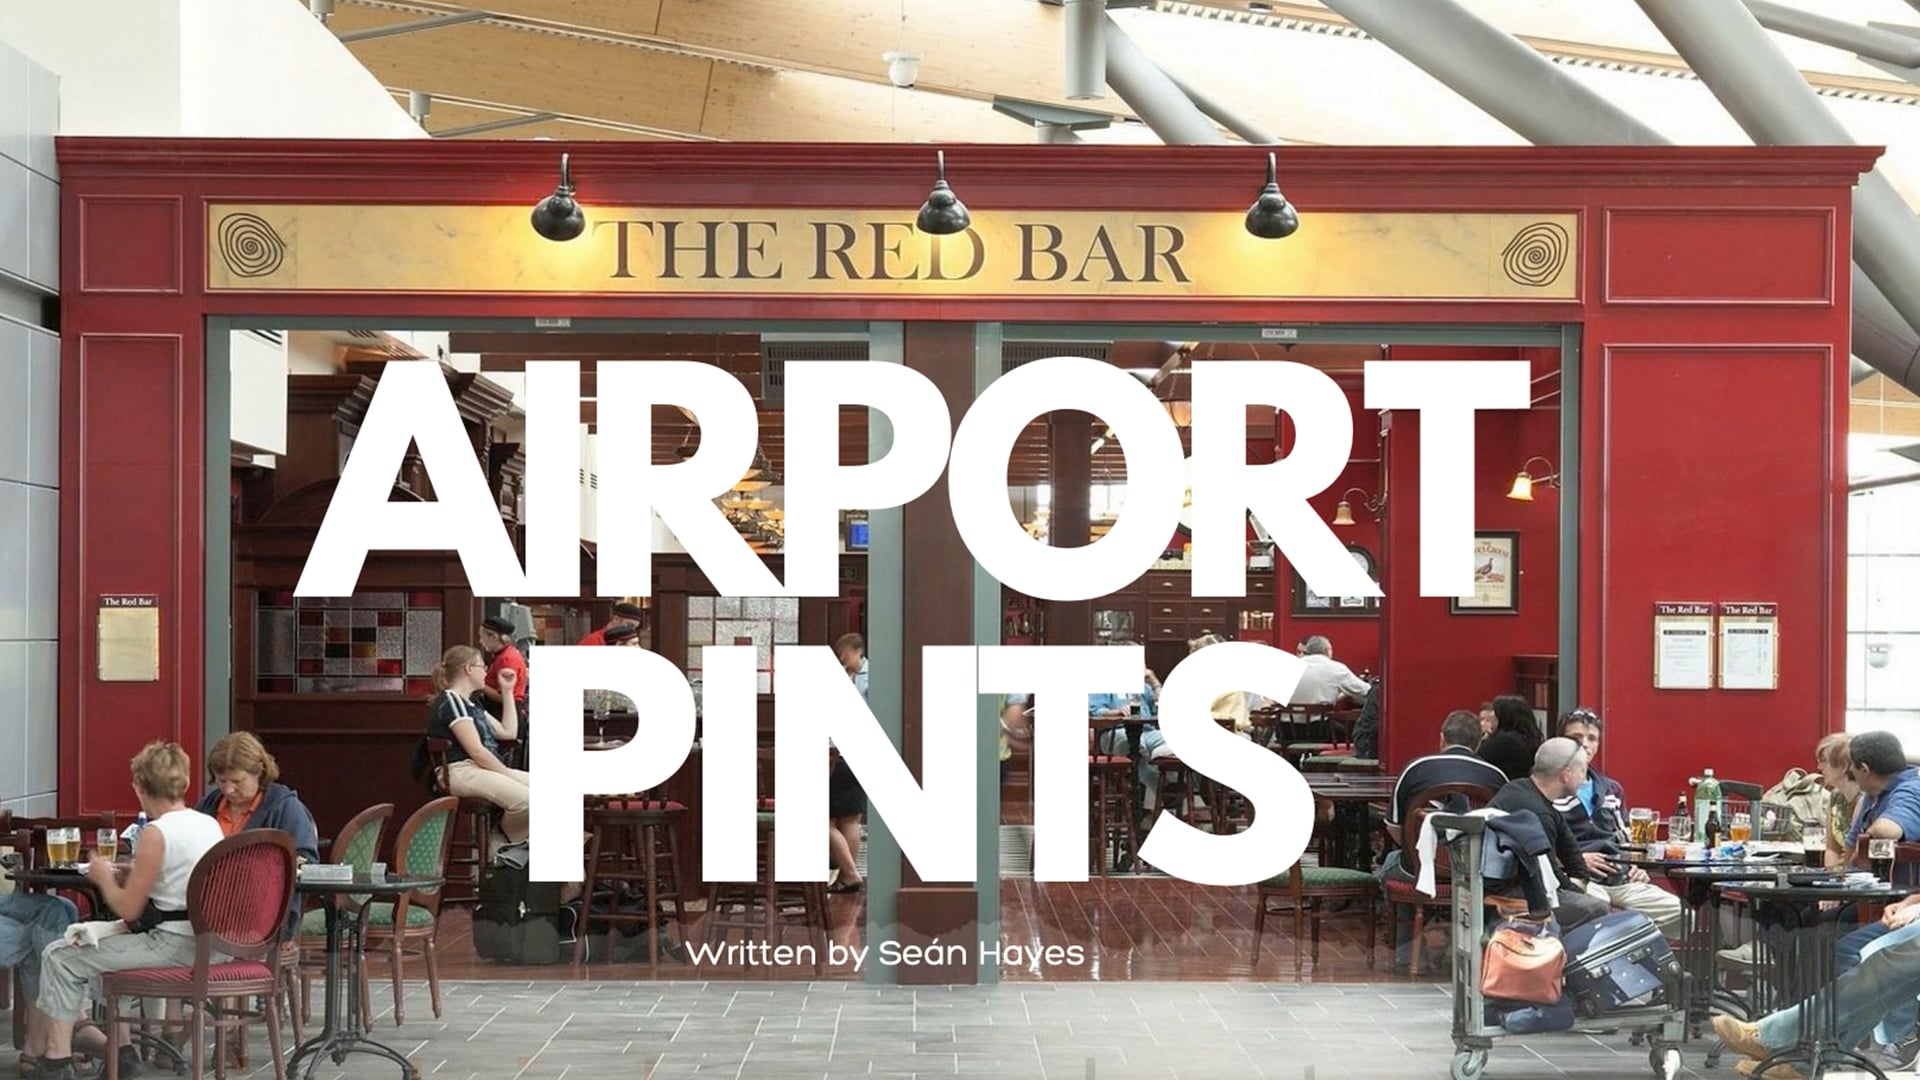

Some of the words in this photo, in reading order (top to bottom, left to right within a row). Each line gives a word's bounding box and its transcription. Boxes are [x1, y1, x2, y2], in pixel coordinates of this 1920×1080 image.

[591, 220, 783, 279] THE
[807, 222, 985, 281] RED
[1013, 223, 1192, 283] BAR
[103, 597, 120, 606] The
[121, 597, 137, 606] Red
[138, 597, 153, 606] Bar
[1660, 605, 1678, 614] The
[1679, 605, 1693, 614] Red
[1694, 606, 1709, 614] Bar
[1725, 605, 1741, 615] The
[1742, 605, 1757, 615] Red
[1758, 605, 1773, 615] Bar
